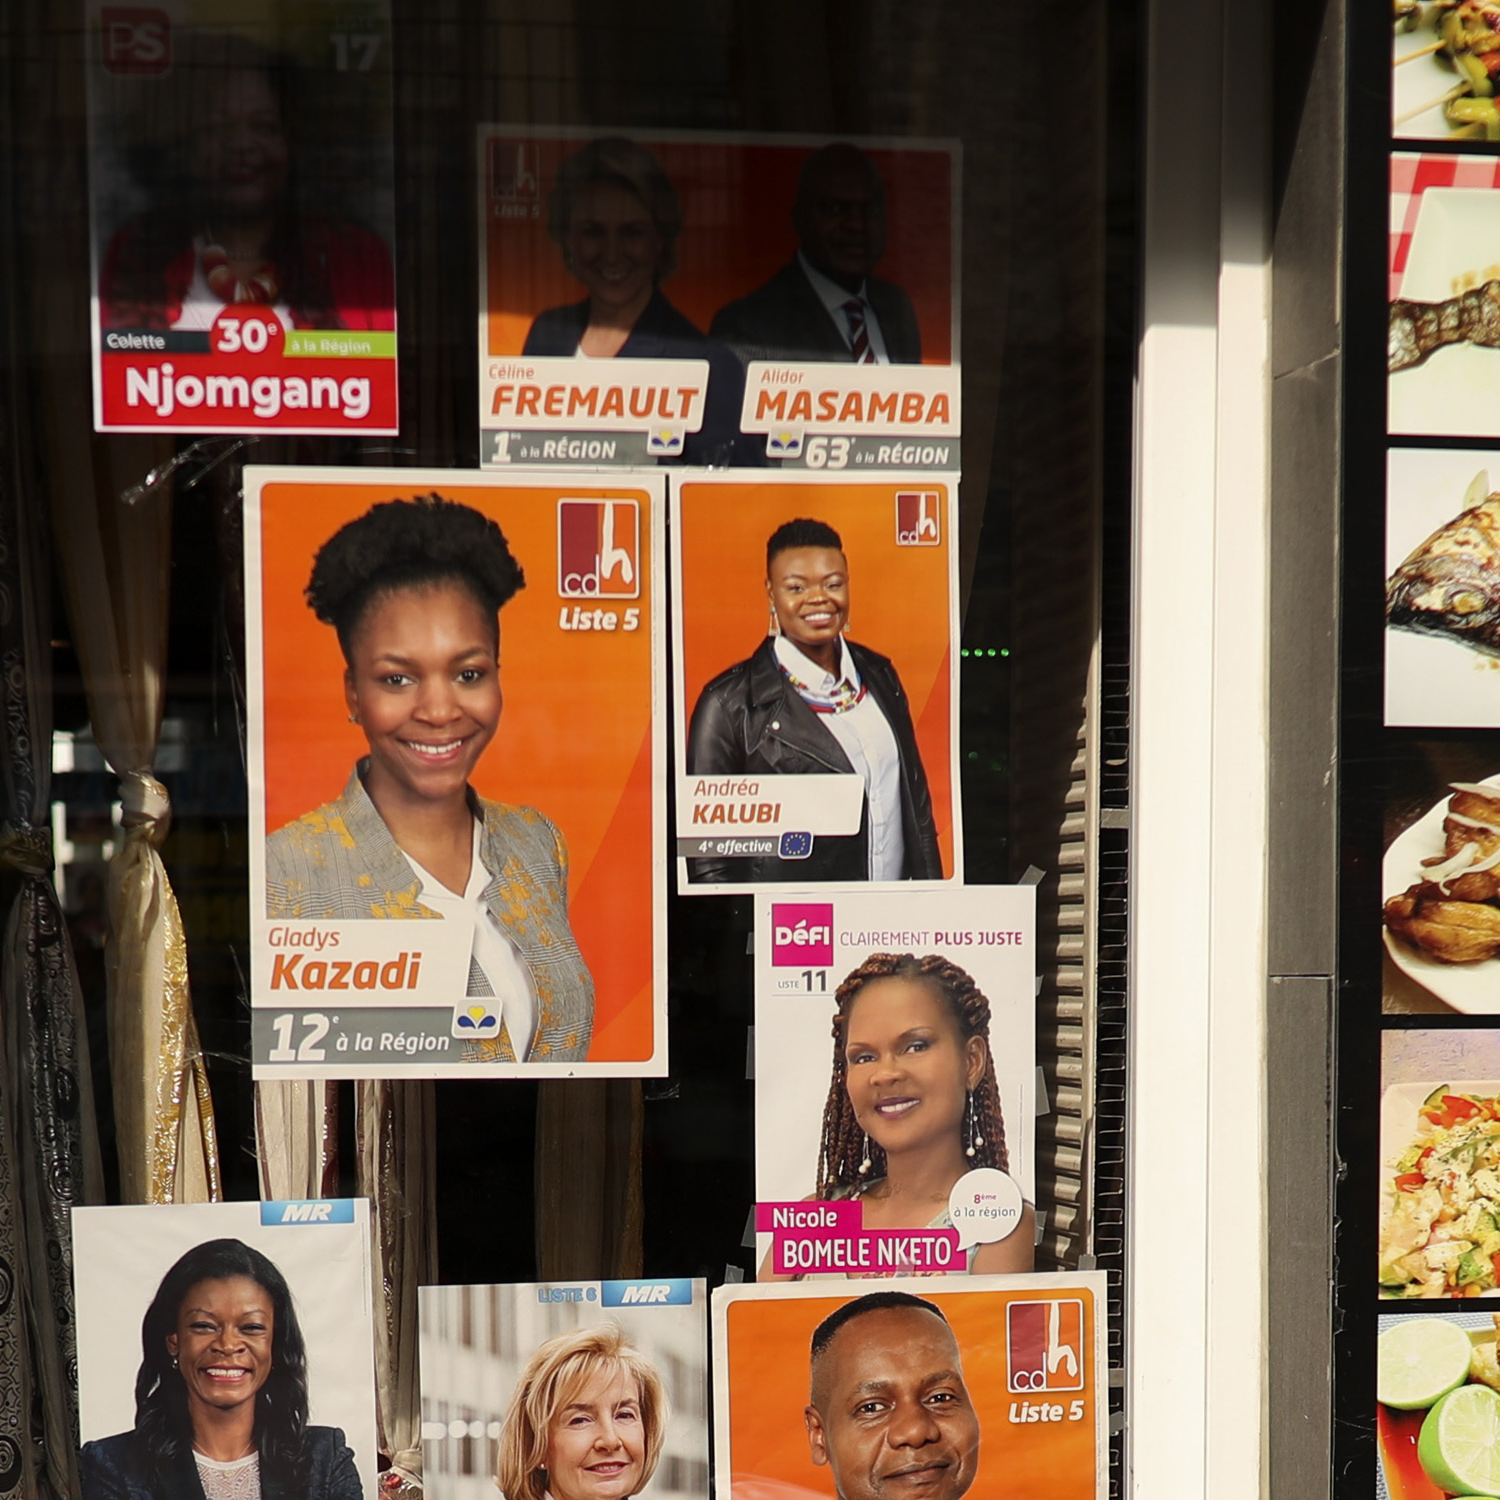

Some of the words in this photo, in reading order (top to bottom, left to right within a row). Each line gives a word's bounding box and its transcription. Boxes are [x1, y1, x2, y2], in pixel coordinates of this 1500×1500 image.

[109, 22, 165, 61] PS
[330, 33, 381, 71] 17
[106, 332, 166, 350] Colette
[304, 338, 316, 352] la
[321, 337, 371, 355] Région
[488, 363, 535, 379] Céline
[760, 368, 805, 384] Alidor
[125, 362, 372, 419] Njomgang
[491, 384, 699, 420] FREMAULT
[755, 388, 951, 424] MASAMBA
[543, 436, 616, 459] RÉGION
[877, 441, 949, 465] RÉGION
[899, 492, 937, 545] cdh
[563, 501, 633, 596] cdh
[559, 607, 618, 631] Liste
[622, 607, 640, 631] 5
[694, 779, 760, 796] Andréa
[692, 803, 782, 825] KALUBI
[717, 839, 773, 856] effective
[268, 926, 341, 953] Gladys
[775, 919, 831, 947] DéFI
[839, 931, 930, 947] CLAIREMENT
[934, 931, 973, 946] PLUS
[977, 931, 1023, 947] JUSTE
[269, 951, 422, 992] Kazadi
[778, 980, 800, 989] LISTE
[801, 970, 827, 992] 11
[336, 1031, 349, 1053] à
[353, 1031, 374, 1053] la
[378, 1031, 450, 1057] Région
[281, 1202, 332, 1223] MR
[773, 1207, 838, 1229] Nicole
[964, 1207, 975, 1217] la
[979, 1207, 1016, 1219] région
[782, 1237, 871, 1269] BOMELE
[877, 1235, 952, 1267] NKETO
[537, 1287, 585, 1304] LISTE
[621, 1285, 672, 1304] MR
[1012, 1302, 1079, 1391] cdh
[1008, 1402, 1064, 1424] Liste
[1068, 1400, 1084, 1422] 5
